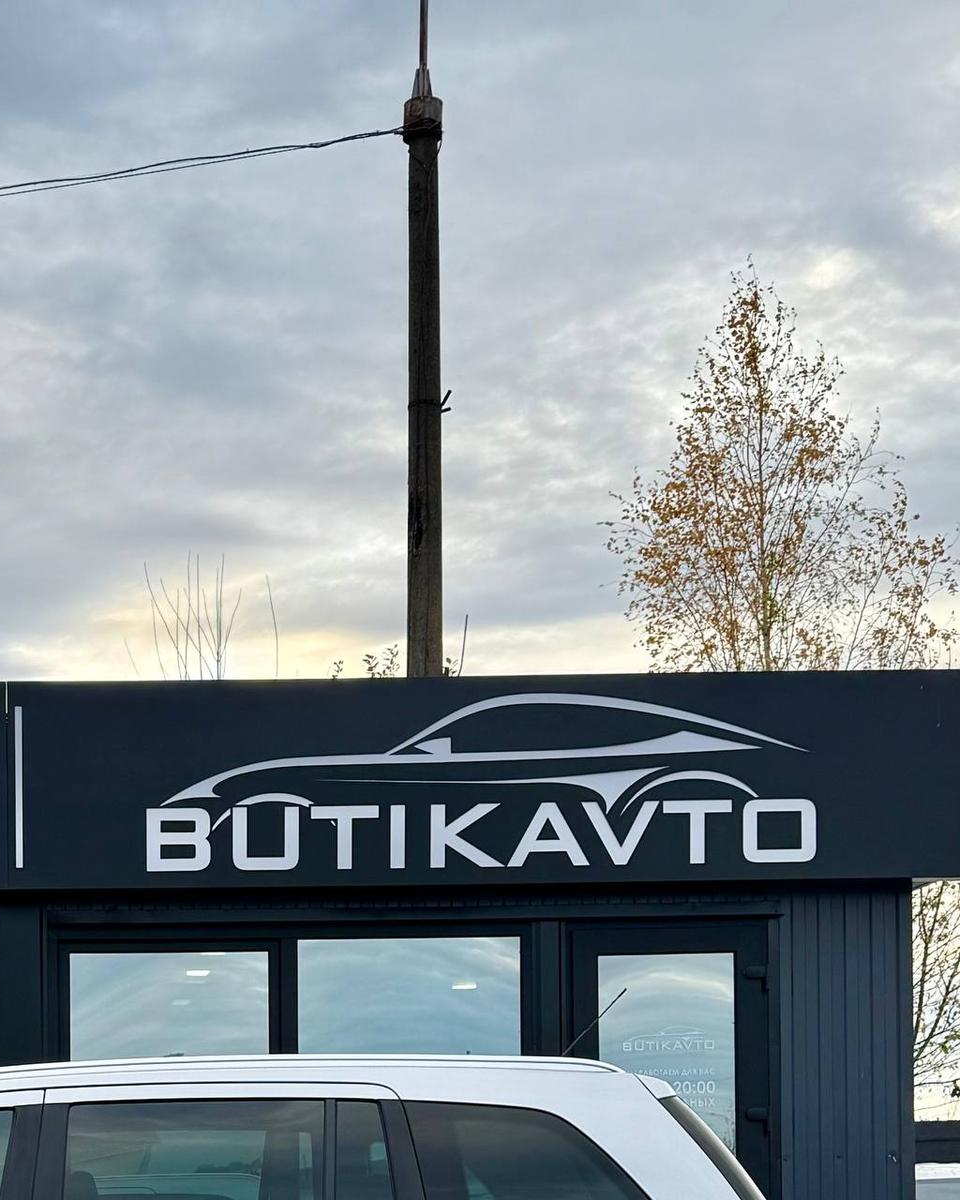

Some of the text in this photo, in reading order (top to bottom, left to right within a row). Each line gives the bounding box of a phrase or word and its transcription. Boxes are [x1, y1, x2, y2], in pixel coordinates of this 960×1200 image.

[145, 797, 817, 873] BUTIKAVTO
[622, 1039, 715, 1051] BUTIKAVTO
[672, 1080, 716, 1094] 20:00
